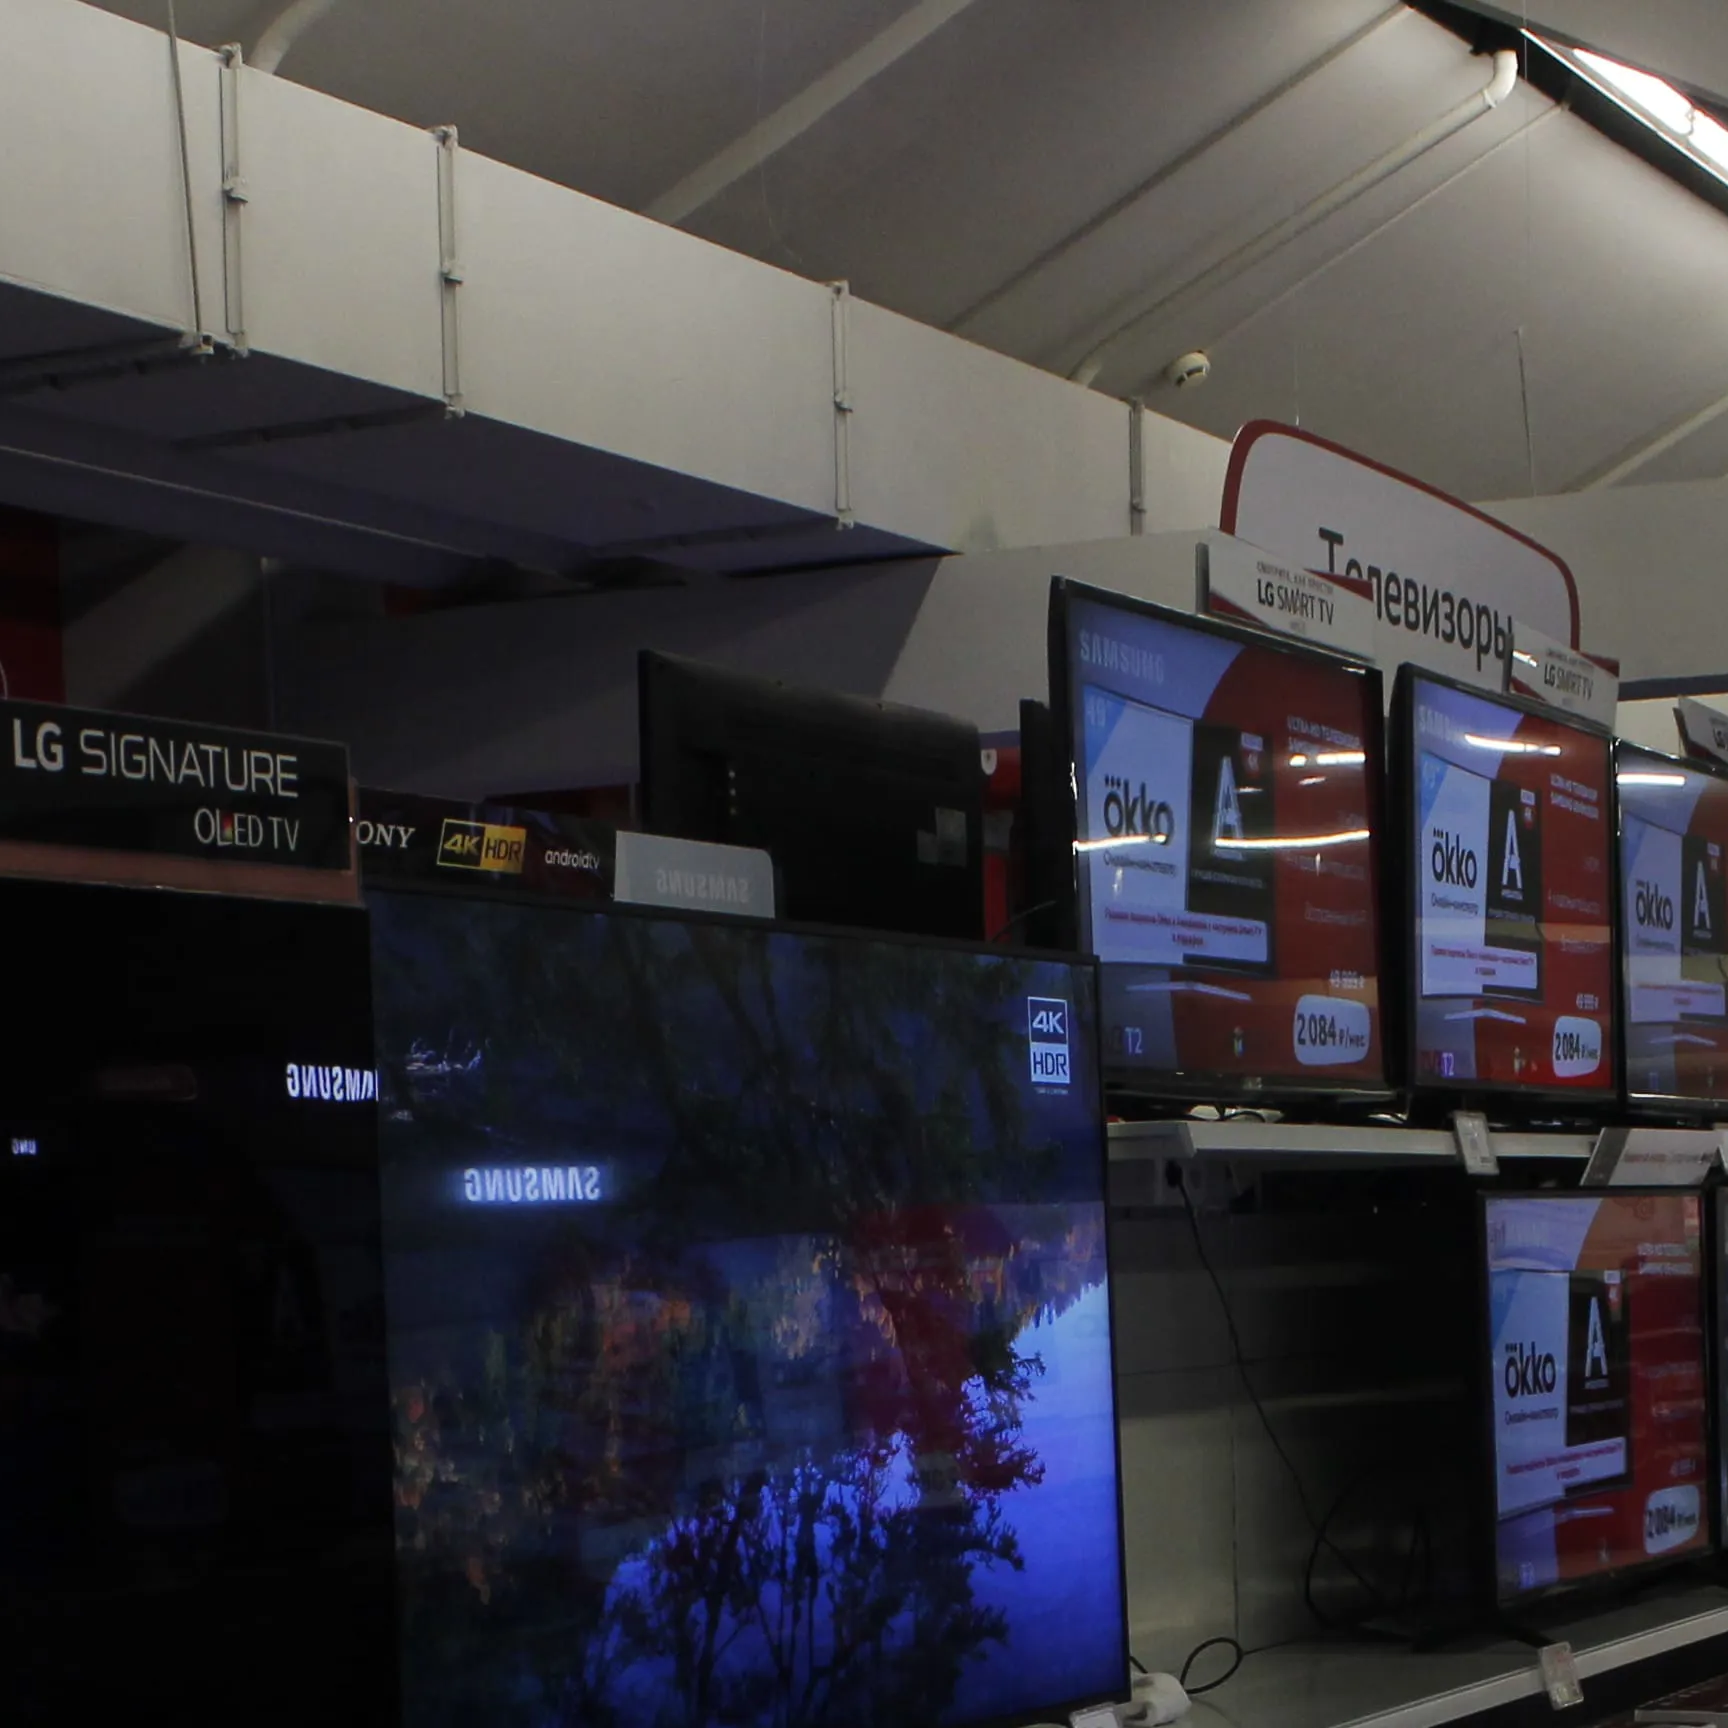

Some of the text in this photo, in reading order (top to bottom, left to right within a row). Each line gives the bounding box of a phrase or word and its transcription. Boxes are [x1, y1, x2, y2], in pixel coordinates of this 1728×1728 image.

[1256, 578, 1334, 626] LG SMART TV
[1079, 630, 1165, 686] SAMSUNG
[1543, 662, 1555, 687] LG
[13, 717, 299, 798] LG SIGNATURE
[194, 807, 300, 851] OLED TV
[355, 820, 416, 849] ONY
[442, 829, 522, 865] 4K HDR
[1032, 1010, 1064, 1034] 4K
[1033, 1052, 1067, 1076] HDR
